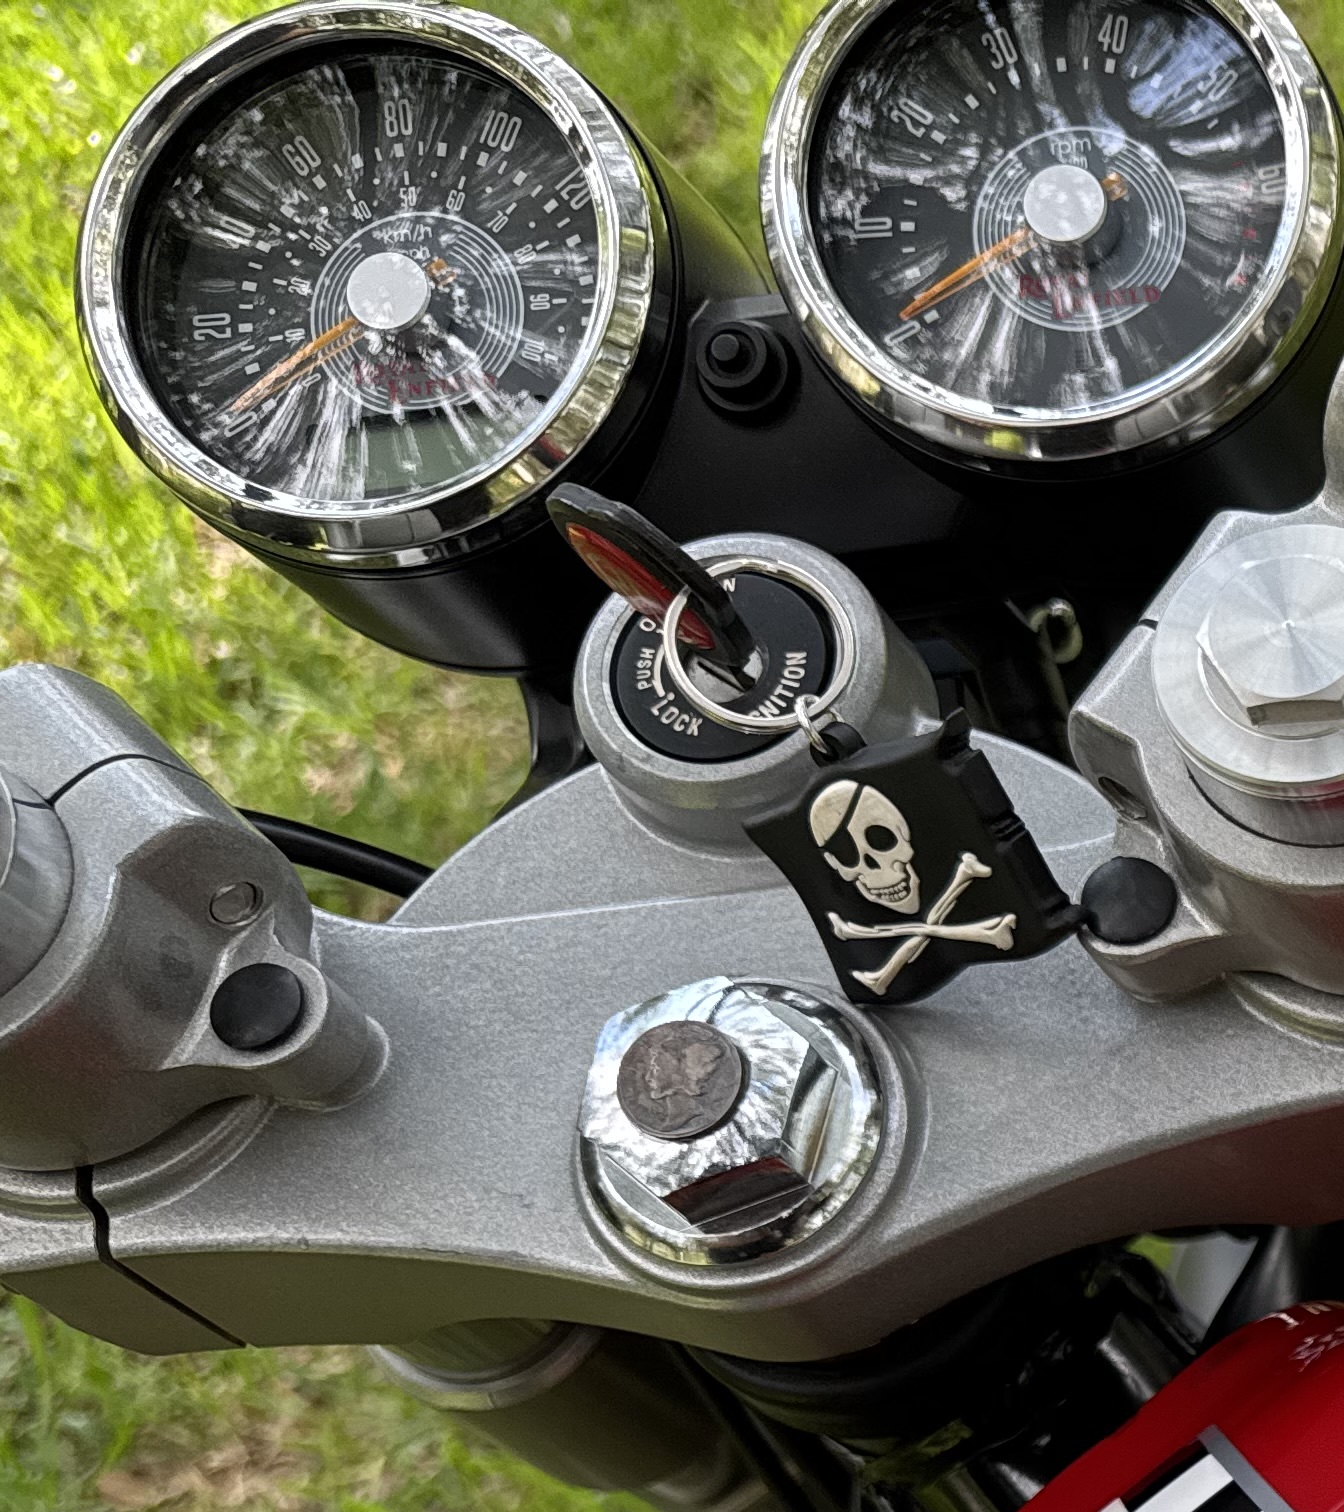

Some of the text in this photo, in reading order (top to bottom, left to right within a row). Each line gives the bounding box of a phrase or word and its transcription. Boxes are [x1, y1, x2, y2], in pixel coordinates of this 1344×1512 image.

[1098, 13, 1129, 54] 40
[981, 27, 1018, 70] 30
[1199, 63, 1239, 101] 50
[384, 99, 412, 137] 80
[479, 110, 522, 152] 100
[890, 98, 934, 138] 20
[281, 135, 321, 176] 60
[1050, 138, 1092, 161] rpm
[352, 200, 372, 222] 40
[446, 189, 466, 212] 60
[486, 210, 509, 233] 70
[855, 217, 893, 239] 10
[308, 235, 332, 257] 30
[513, 243, 537, 265] 80
[529, 293, 550, 311] 90
[192, 313, 231, 341] 20
[884, 320, 921, 347] 0
[302, 372, 321, 387] 0
[224, 411, 258, 437] 0
[637, 648, 655, 690] PUSH
[749, 651, 808, 719] NITION
[651, 699, 703, 737] LOCK
